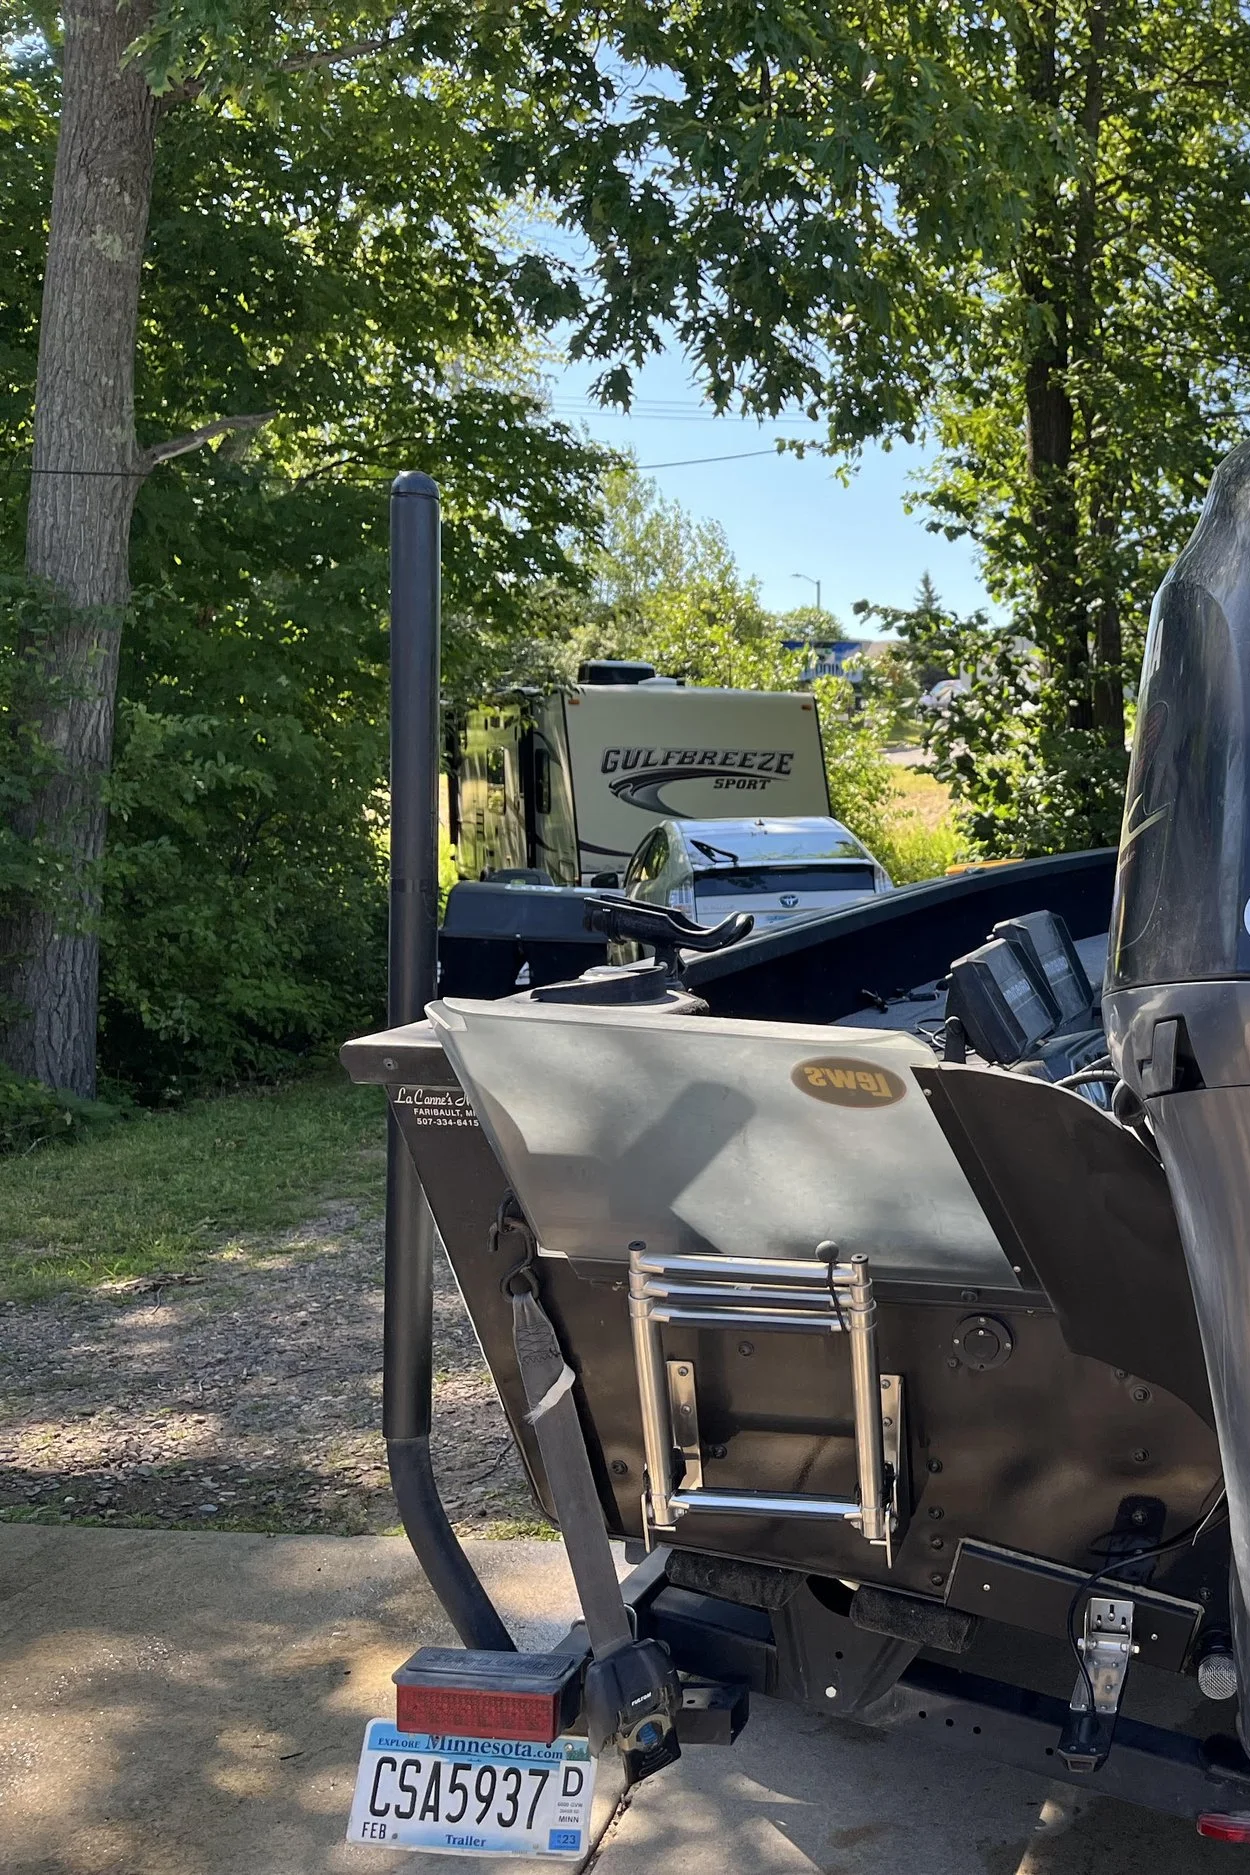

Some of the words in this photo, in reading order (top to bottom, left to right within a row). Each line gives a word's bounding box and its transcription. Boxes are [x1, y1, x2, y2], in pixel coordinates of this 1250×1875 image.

[600, 748, 795, 776] GULFBREEZE
[713, 778, 772, 791] SPORT
[413, 1108, 463, 1117] FARIBAULT,
[416, 1117, 479, 1127] 507-334-6415
[378, 1737, 421, 1749] EXPLORE
[561, 1766, 584, 1797] D
[369, 1756, 550, 1830] CSA5937
[558, 1815, 579, 1823] MINN
[361, 1821, 387, 1840] FEB
[445, 1834, 486, 1848] Trailer
[562, 1834, 576, 1844] 23
